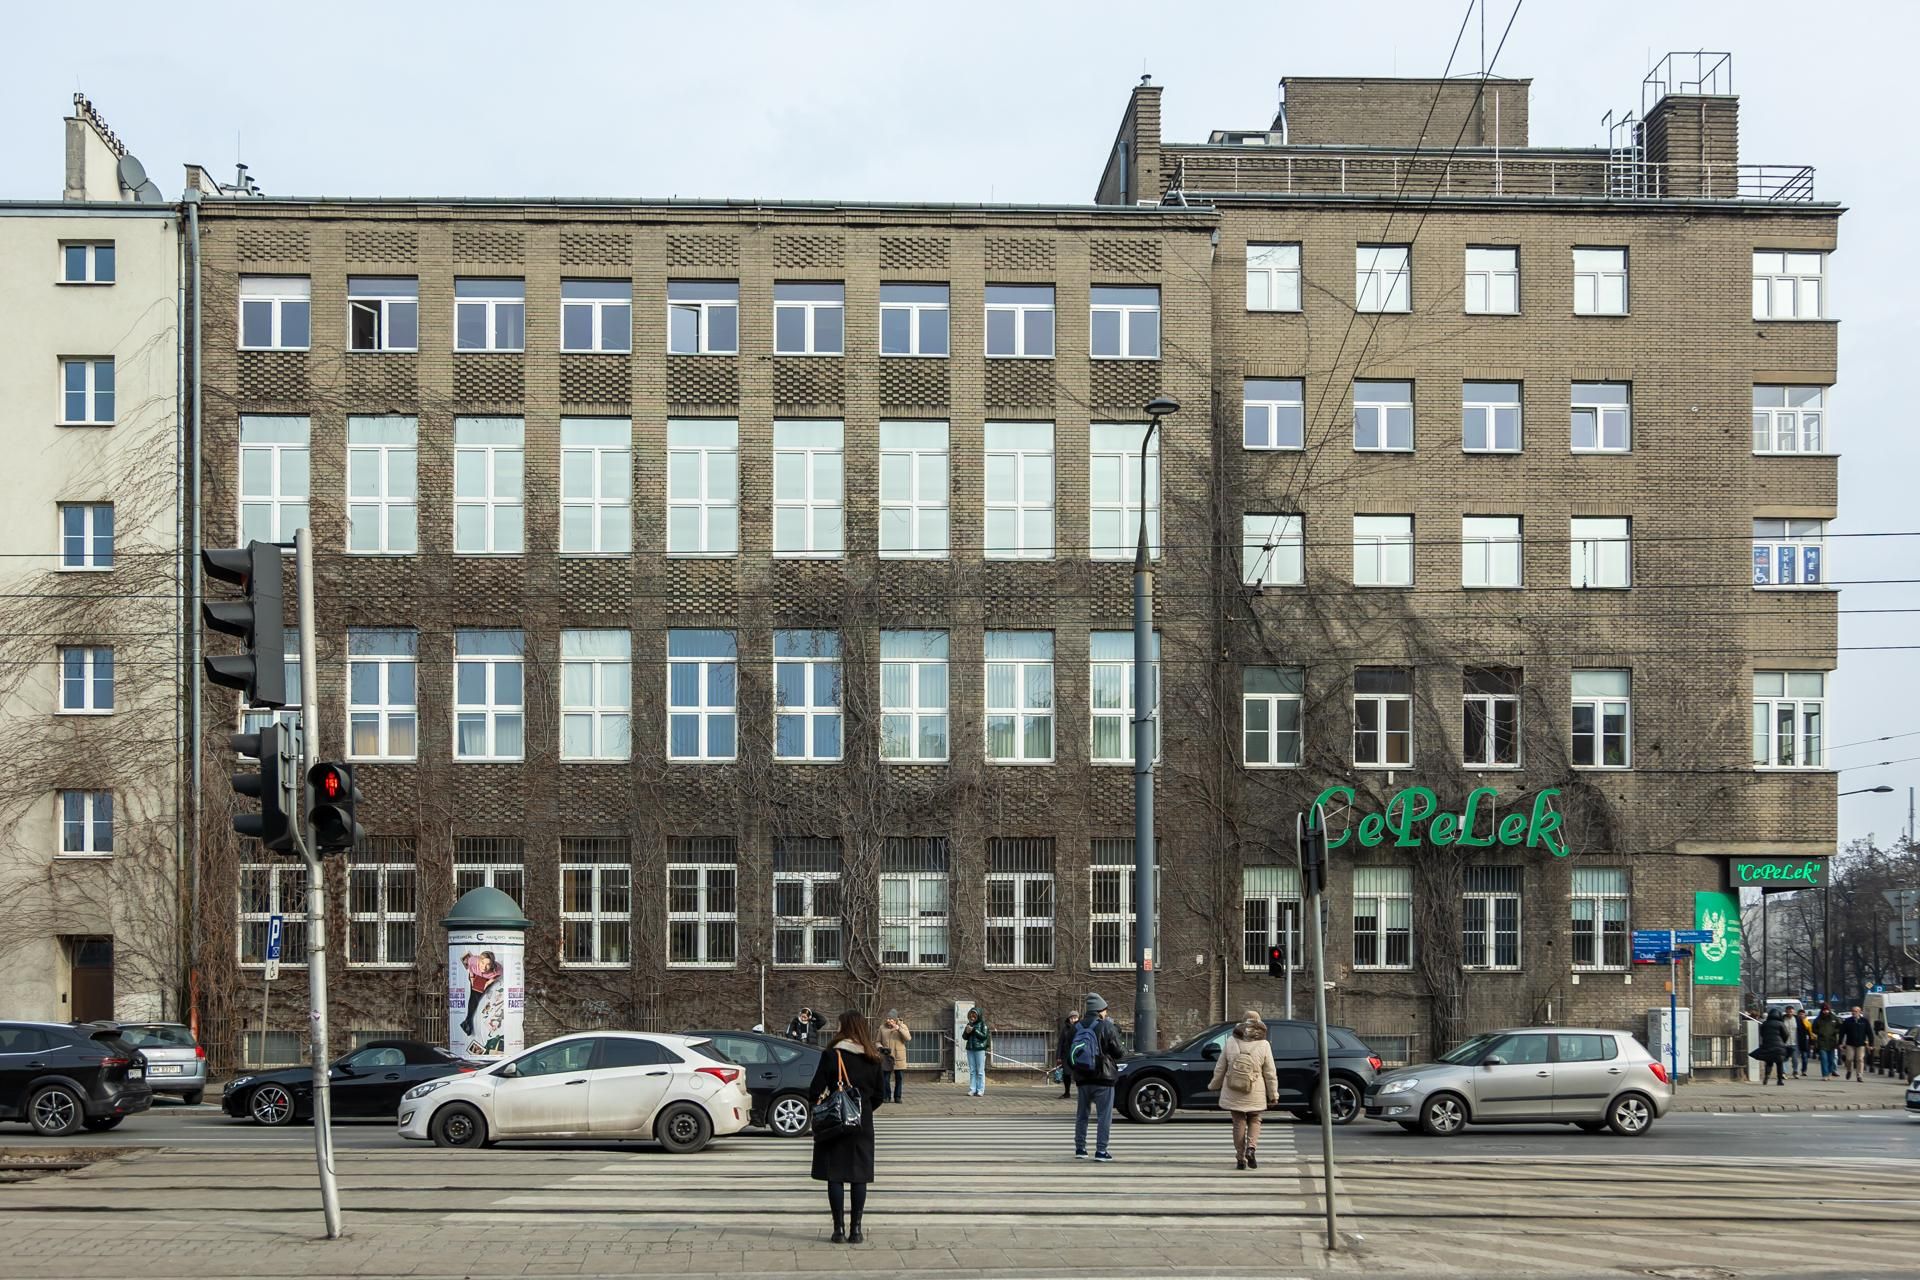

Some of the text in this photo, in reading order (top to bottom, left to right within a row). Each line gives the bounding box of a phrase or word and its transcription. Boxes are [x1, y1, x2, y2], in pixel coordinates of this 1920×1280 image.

[1807, 551, 1816, 582] MED
[1309, 785, 1570, 857] CePeLek
[1737, 861, 1821, 884] "CePeLek"
[271, 919, 280, 947] P
